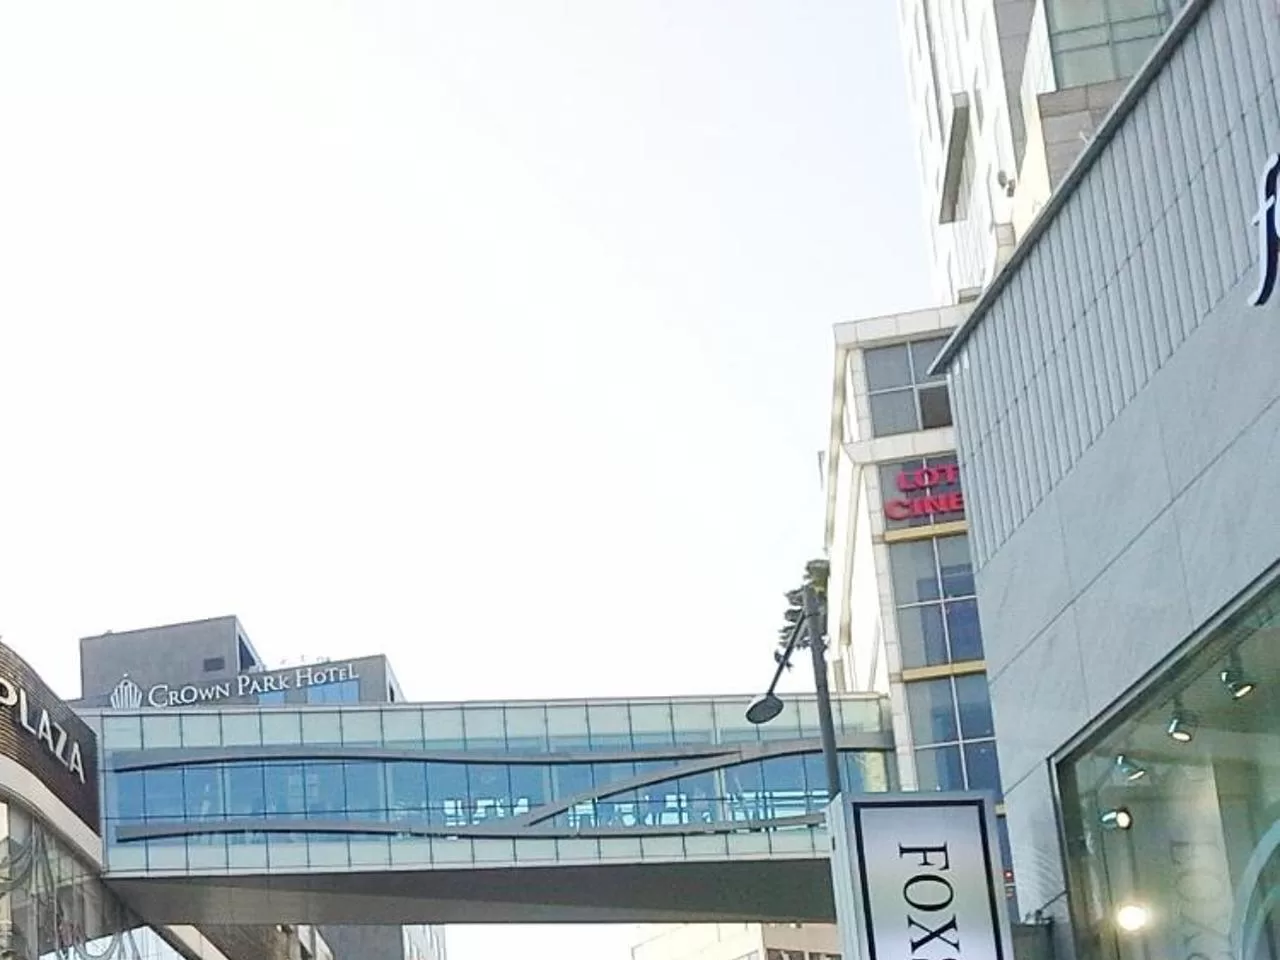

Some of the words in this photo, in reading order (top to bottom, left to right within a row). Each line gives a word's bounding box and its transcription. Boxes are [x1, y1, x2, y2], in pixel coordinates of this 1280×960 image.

[148, 682, 230, 708] CROWN
[236, 674, 290, 697] PARK
[295, 663, 360, 688] HOTEL
